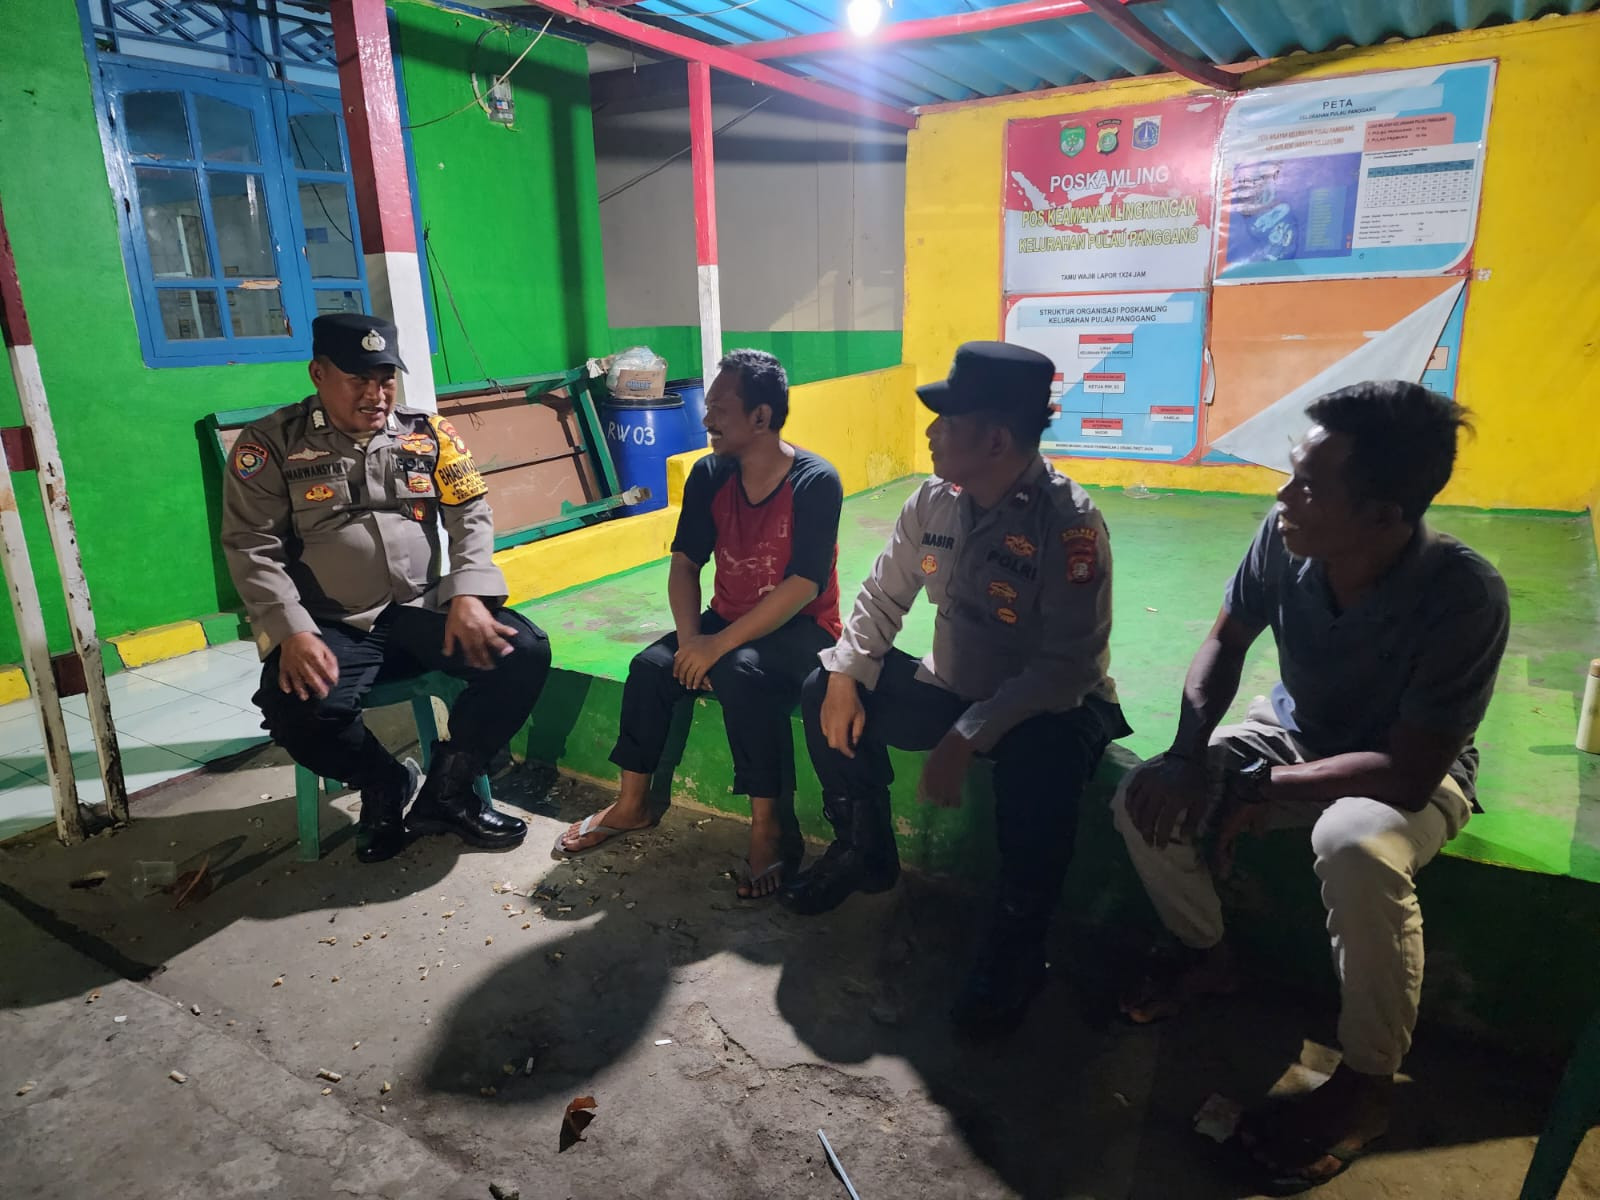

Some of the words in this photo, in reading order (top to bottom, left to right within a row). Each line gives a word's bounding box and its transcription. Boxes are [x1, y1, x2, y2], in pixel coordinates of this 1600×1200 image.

[1322, 99, 1353, 110] PETA
[1050, 166, 1169, 193] POSKAMLING
[1022, 210, 1045, 228] POS
[1047, 204, 1112, 226] KEAMANAN
[1115, 197, 1198, 221] LINGKUNGAN
[1018, 234, 1086, 254] KELURAHAN
[1088, 231, 1127, 249] PULAU
[1129, 227, 1199, 247] PANGGANG
[1133, 270, 1146, 278] JAM
[1039, 308, 1075, 316] STRUKTUR
[1076, 306, 1119, 315] ORGANISASI
[1120, 305, 1168, 313] POSKAMLING
[1048, 315, 1090, 324] KELURAHAN
[1091, 315, 1115, 323] PULAU
[1115, 314, 1157, 323] PANGGANG
[607, 421, 631, 443] RW
[633, 426, 656, 446] 03
[921, 532, 955, 550] NASIR
[987, 549, 1039, 580] POLRI
